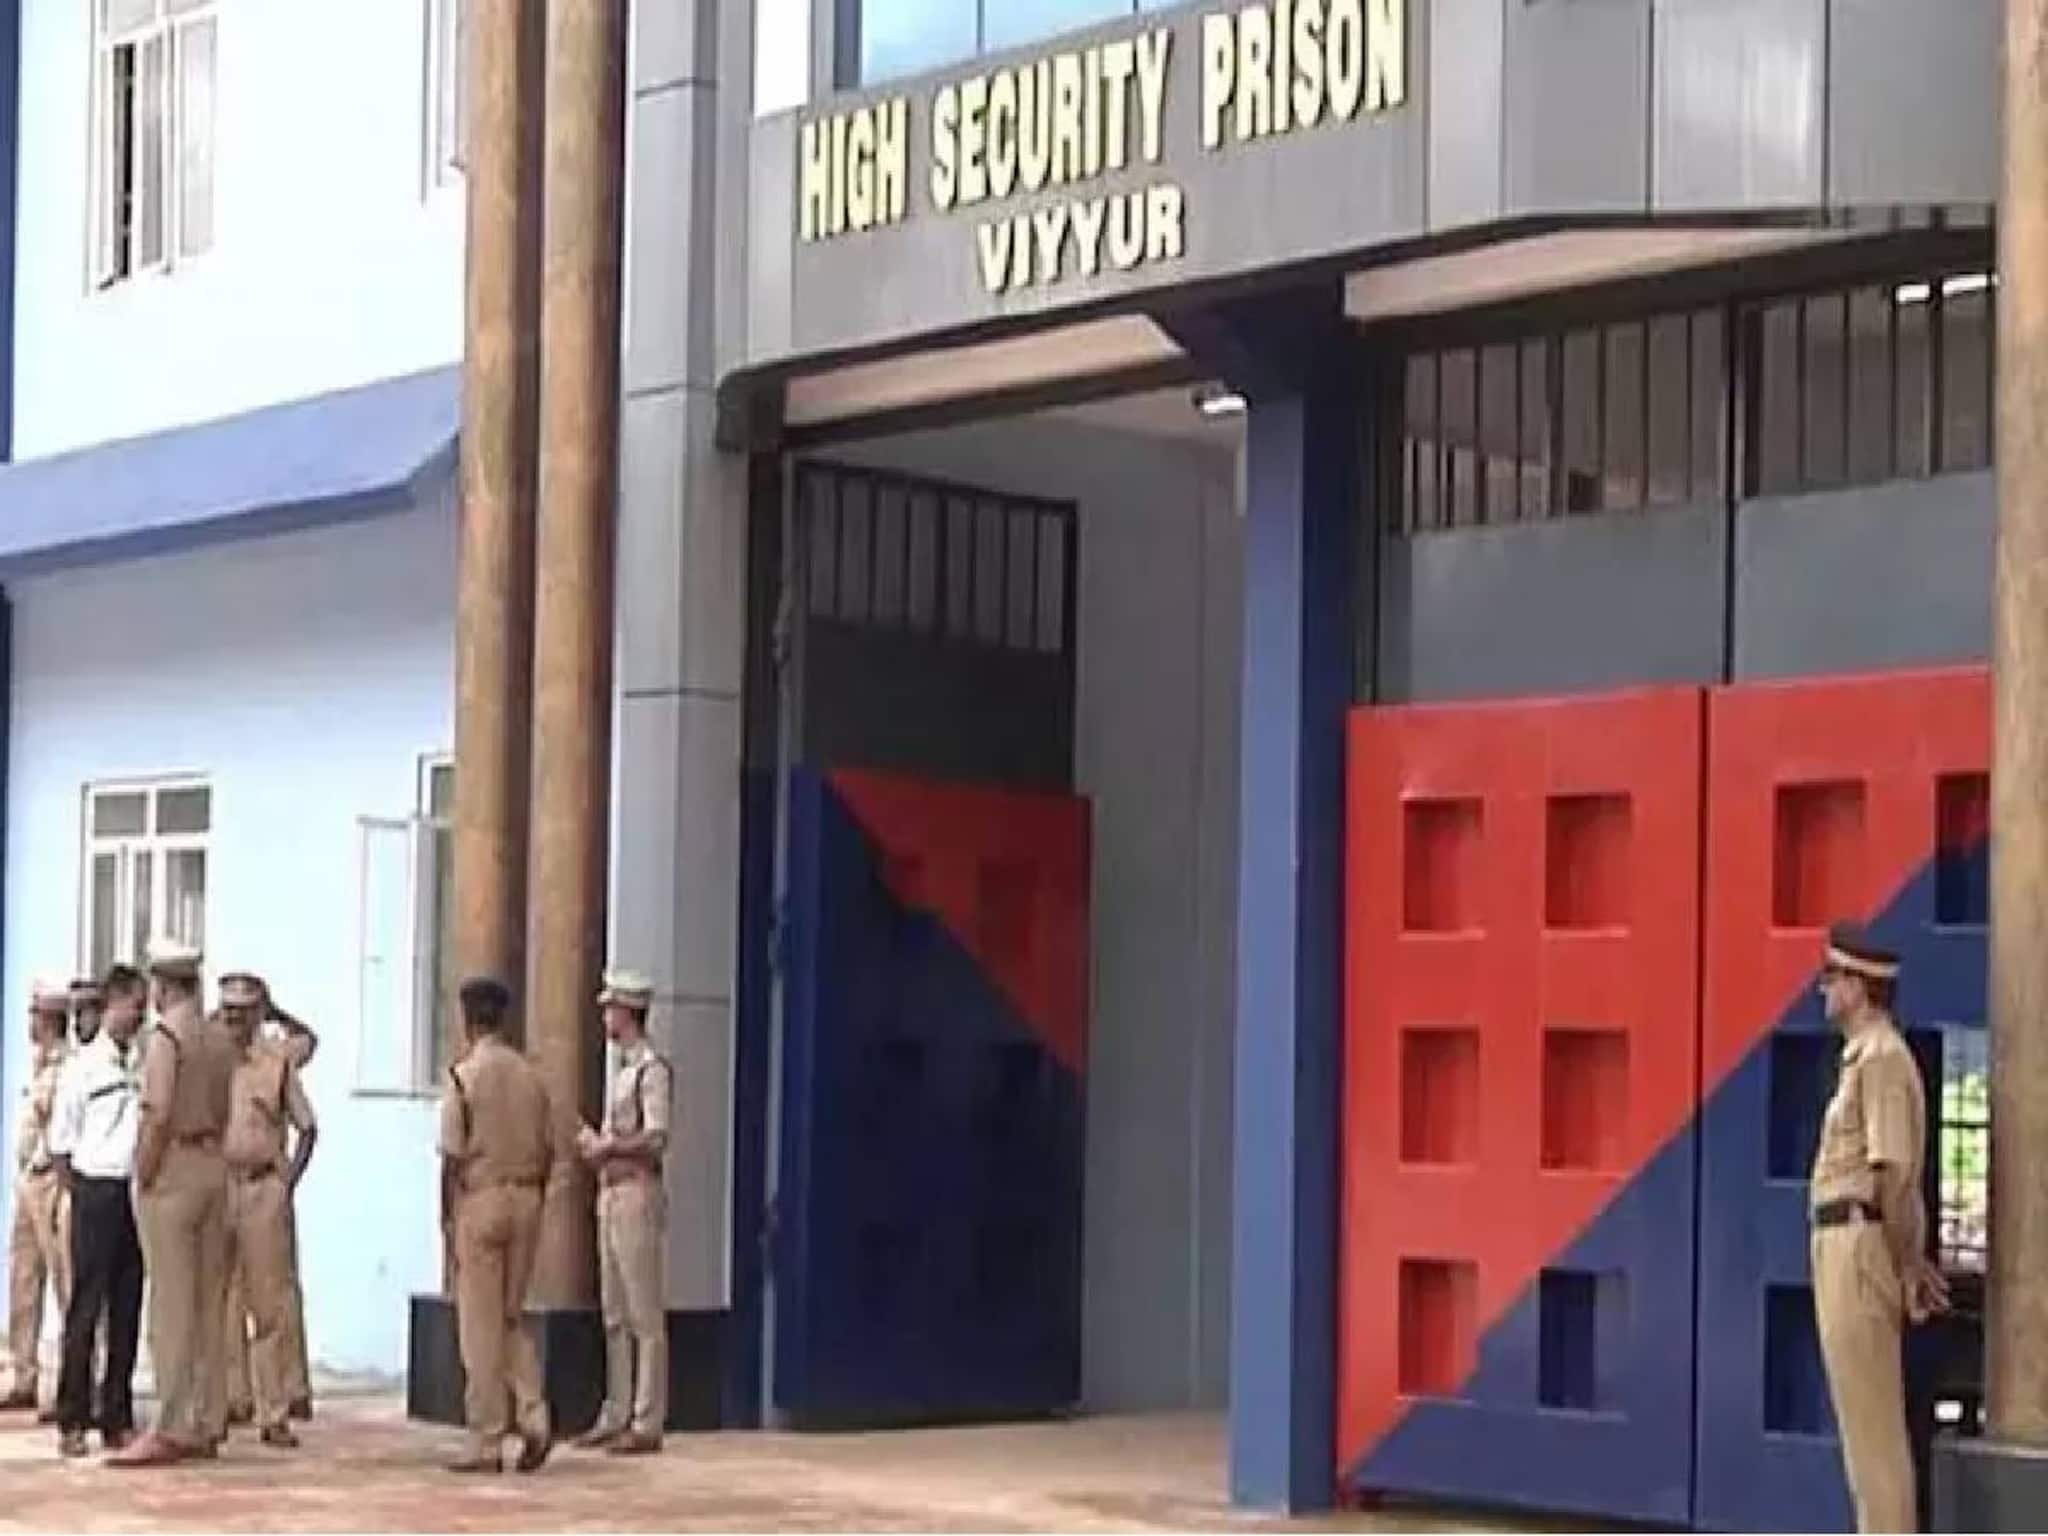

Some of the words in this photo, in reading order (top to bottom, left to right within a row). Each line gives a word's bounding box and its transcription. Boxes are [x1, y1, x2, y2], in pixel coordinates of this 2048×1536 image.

[799, 98, 907, 241] HIGH
[931, 29, 1173, 211] SECURITY
[1202, 0, 1406, 150] PRISON
[977, 184, 1186, 293] VIYYUR
